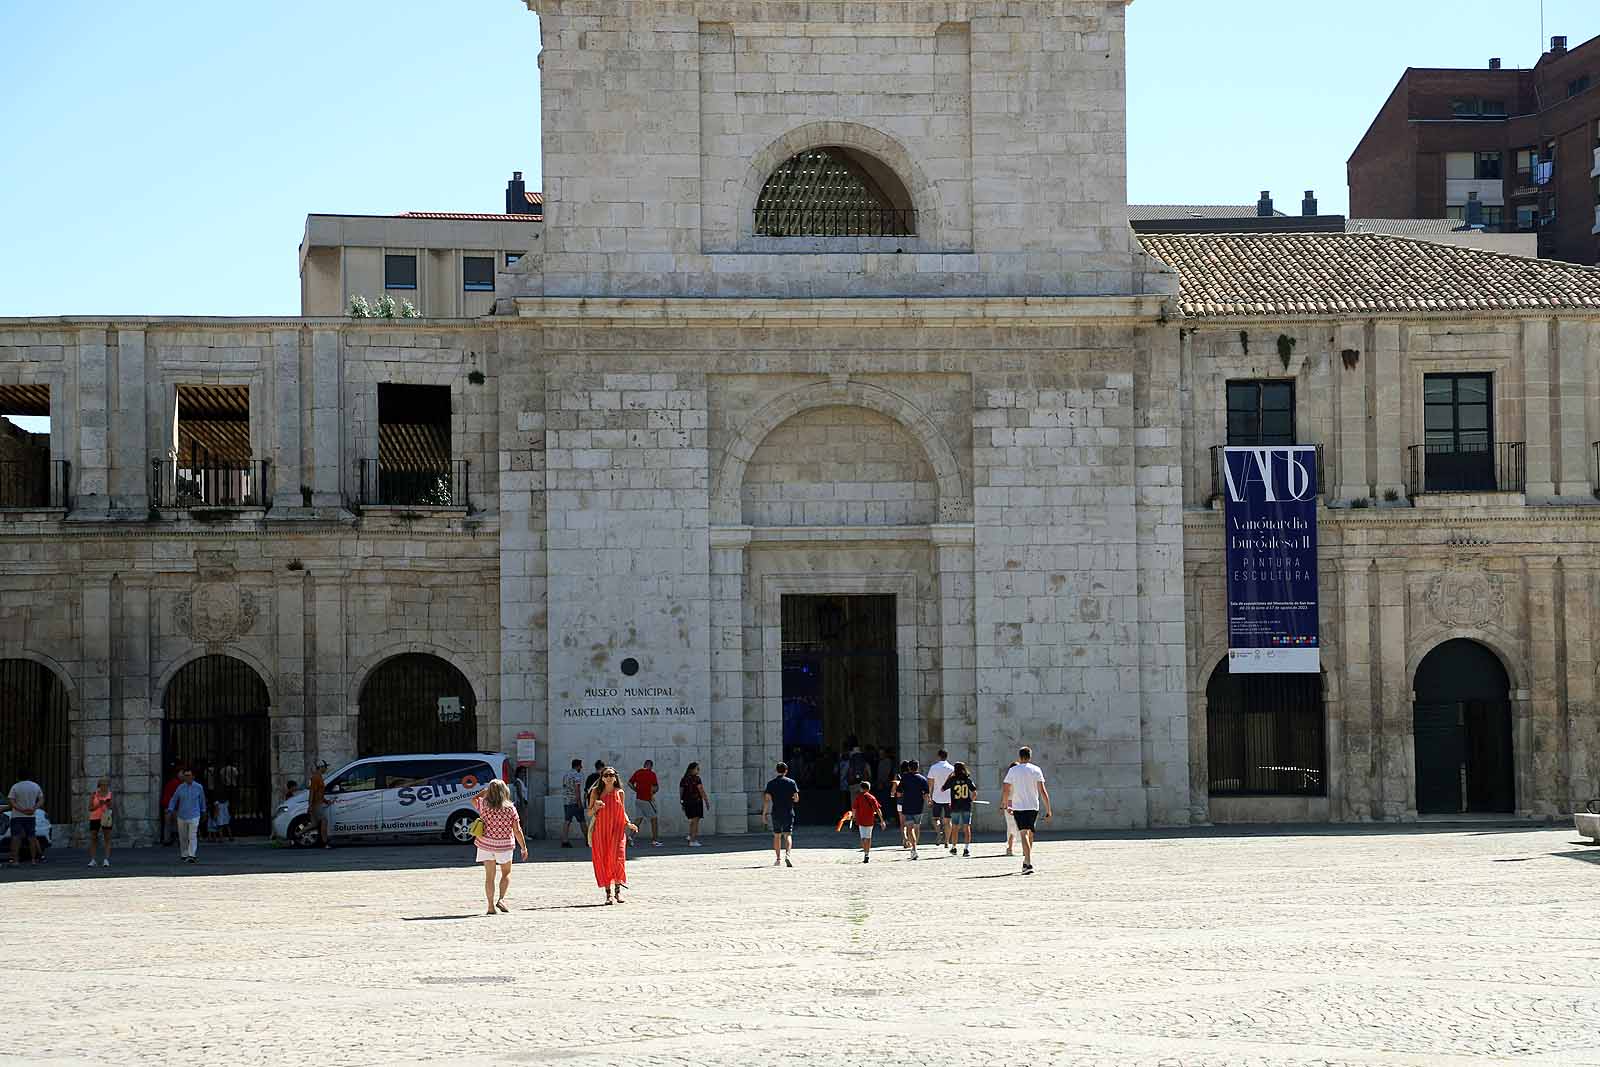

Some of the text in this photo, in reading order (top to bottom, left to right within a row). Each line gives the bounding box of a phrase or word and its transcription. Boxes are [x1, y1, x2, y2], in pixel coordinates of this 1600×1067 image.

[1232, 516, 1308, 533] Vanguardia
[1243, 558, 1300, 567] PINTURA
[1234, 571, 1310, 581] ESCULTURA
[584, 688, 673, 697] MUSEO MUNICIPAL
[564, 706, 696, 717] MARCELIANO SANTA MARIA
[398, 775, 481, 806] Seltro
[954, 784, 968, 799] 30
[425, 799, 448, 808] Sonido
[335, 819, 437, 832] Soluciones Audiovisuales
